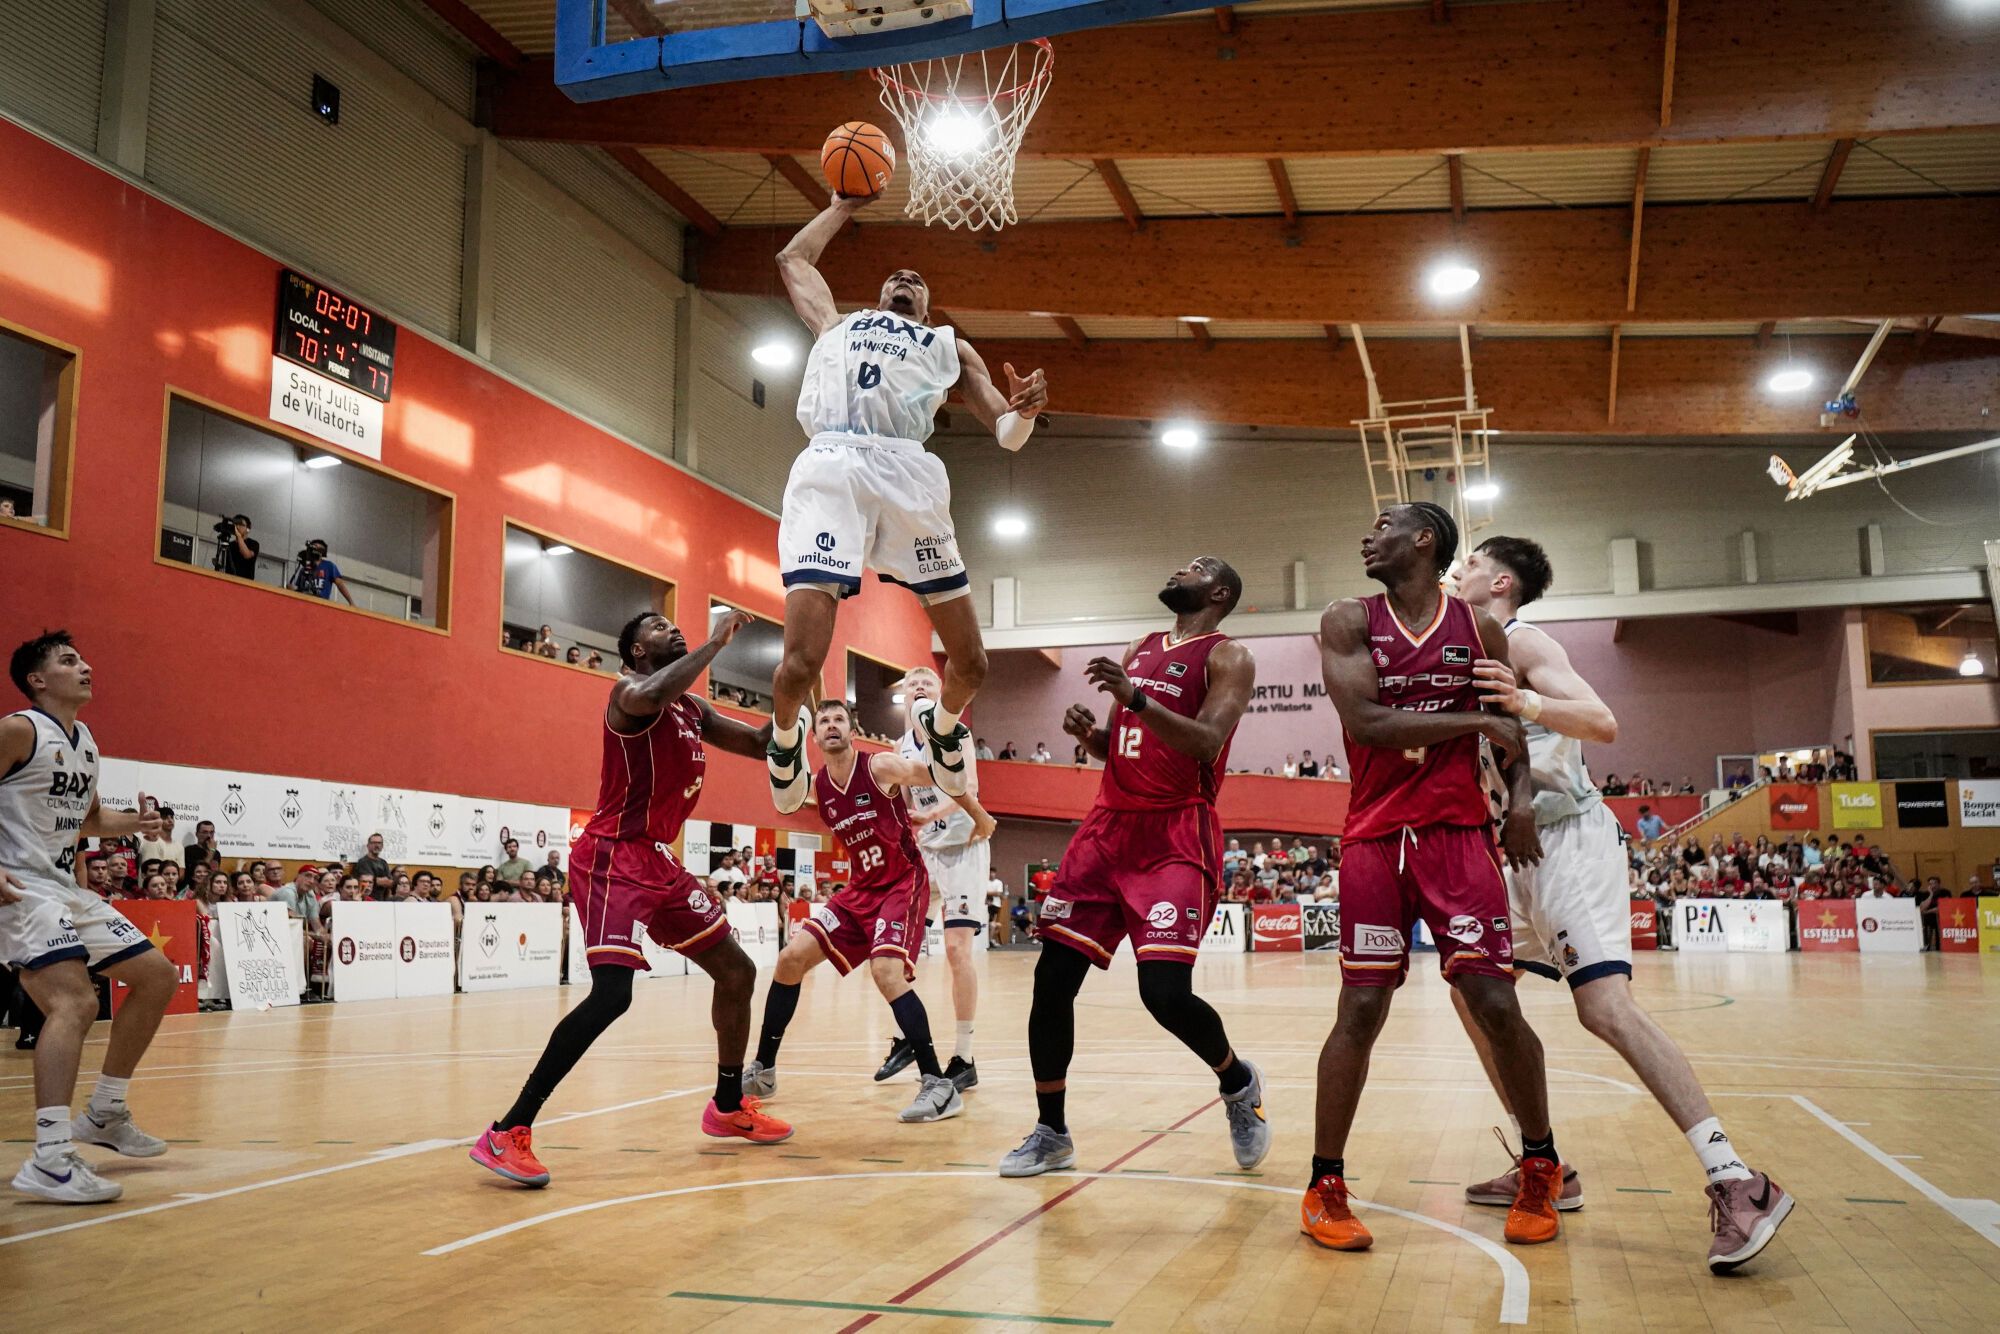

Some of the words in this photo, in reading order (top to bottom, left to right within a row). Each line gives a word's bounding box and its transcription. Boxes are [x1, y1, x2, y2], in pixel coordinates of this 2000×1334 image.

[289, 308, 320, 334] LOCAL
[316, 289, 370, 335] 02:07
[850, 315, 936, 348] BAXI
[296, 331, 318, 364] 70
[336, 344, 345, 361] 4
[361, 343, 390, 367] VISITANT
[849, 339, 908, 362] MANRESA
[368, 365, 389, 395] 77
[290, 372, 321, 401] Sant
[326, 388, 360, 416] Julià
[282, 391, 300, 412] de
[304, 398, 365, 439] Vilatorta
[798, 552, 851, 570] unilabor
[916, 547, 942, 562] ETL
[918, 558, 960, 574] GLOBAL
[1303, 683, 1329, 697] MU
[1256, 704, 1268, 713] de
[1270, 703, 1313, 713] Vilatorta
[1118, 725, 1143, 760] 12
[49, 771, 94, 799] BAX
[859, 845, 885, 872] 22
[47, 933, 79, 947] unila
[1364, 932, 1400, 947] PONS
[1803, 927, 1856, 940] ESTRELLA
[1942, 927, 1977, 940] ESTRELLA
